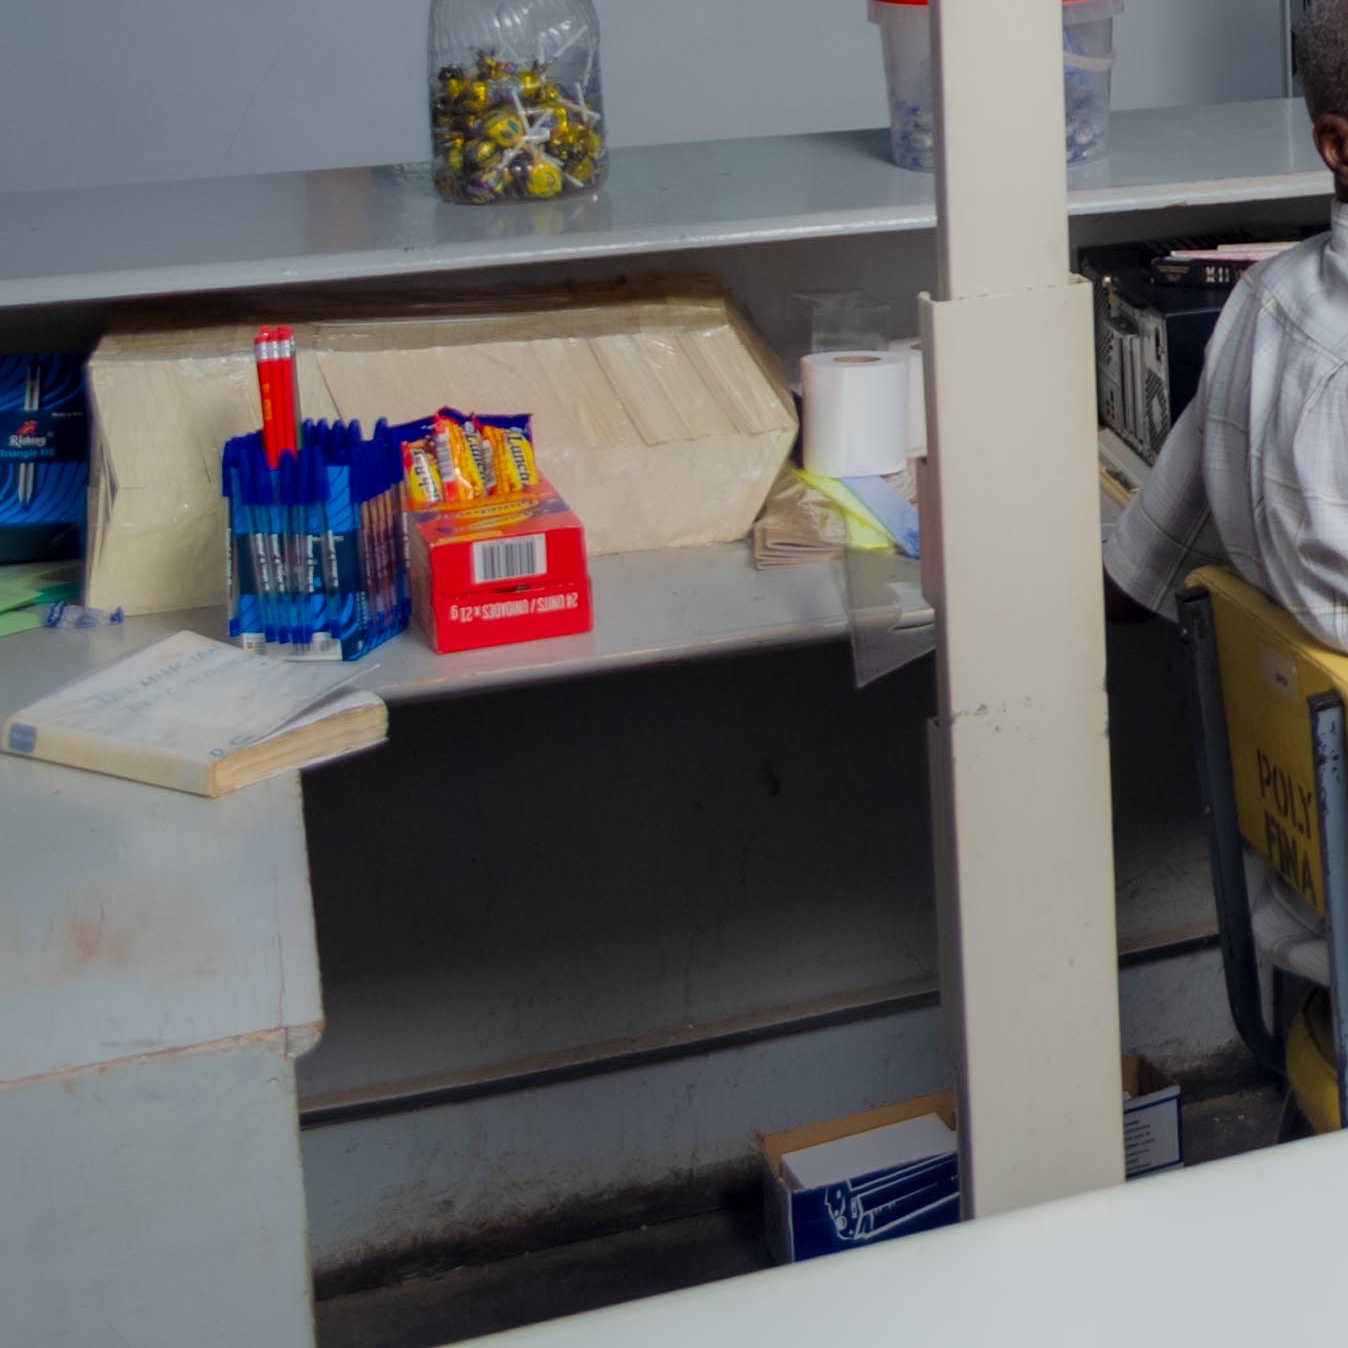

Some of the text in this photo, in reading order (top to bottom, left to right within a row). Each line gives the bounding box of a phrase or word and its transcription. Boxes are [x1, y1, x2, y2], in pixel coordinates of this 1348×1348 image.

[507, 435, 531, 481] Lunch
[482, 599, 529, 620] UNIDADES
[537, 595, 565, 613] UNITS
[565, 592, 578, 610] 24
[459, 608, 473, 622] 21
[1257, 750, 1312, 840] POLY
